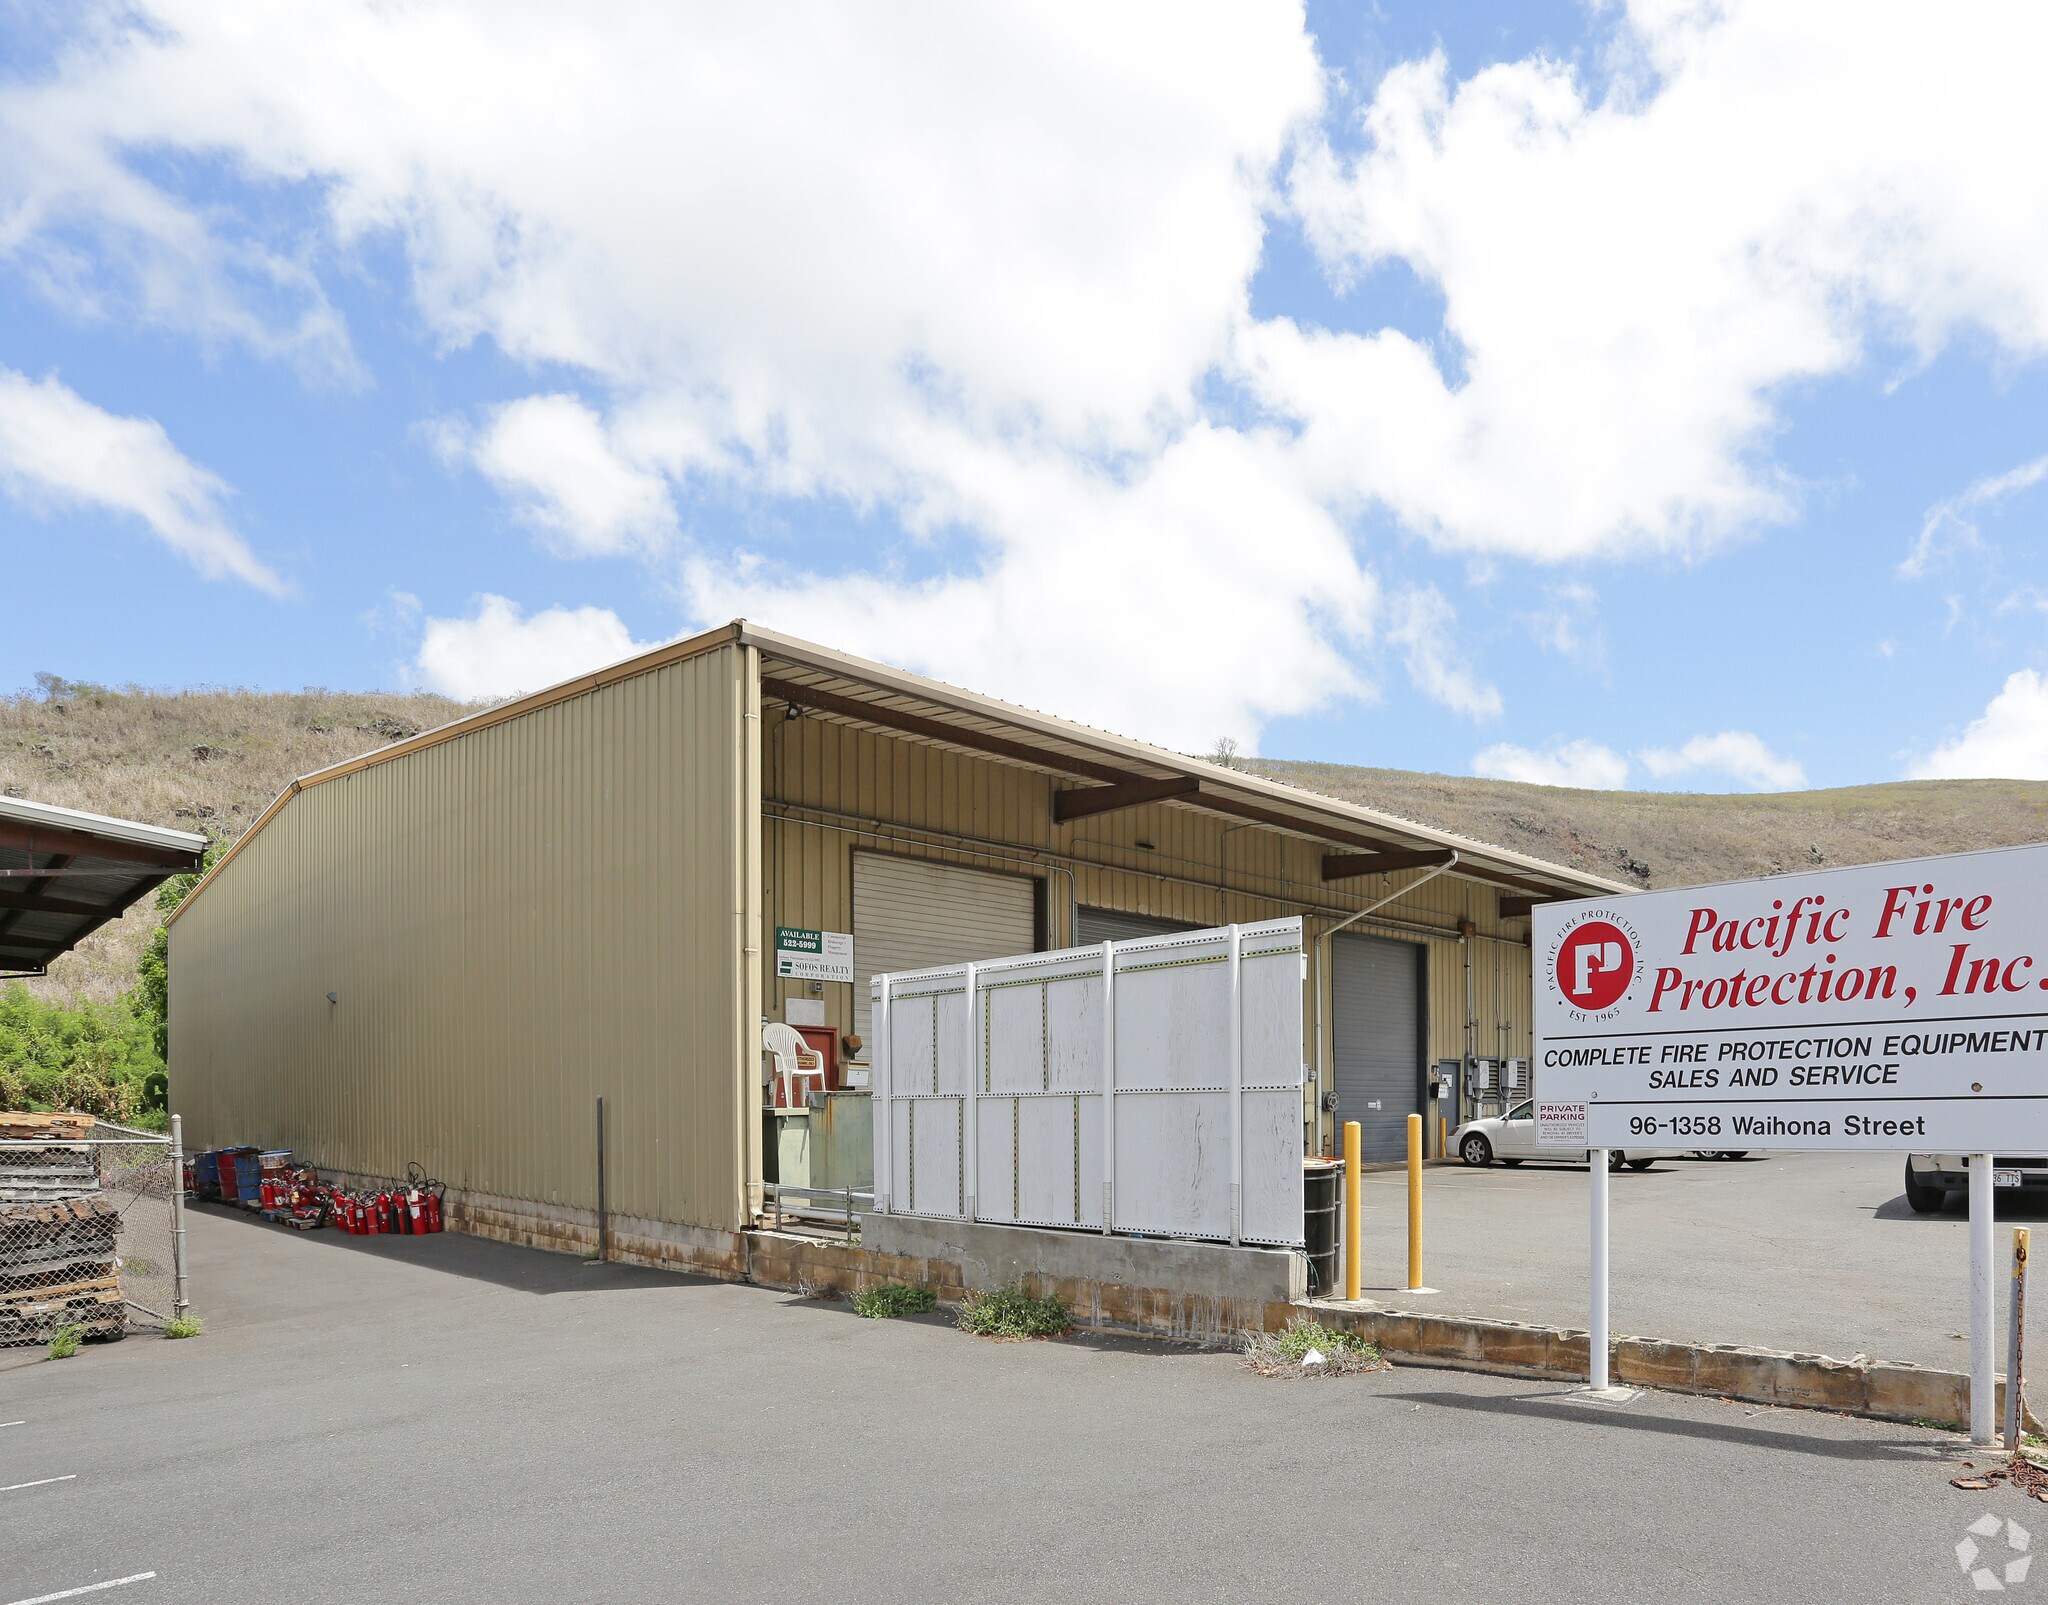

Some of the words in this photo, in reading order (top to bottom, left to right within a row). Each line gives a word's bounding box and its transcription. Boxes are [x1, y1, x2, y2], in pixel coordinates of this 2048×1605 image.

[1680, 895, 1850, 957] Pacific
[1872, 884, 1992, 938] Fire
[780, 930, 820, 940] AVAILABLE
[783, 939, 817, 949] 522-5999
[1546, 942, 1558, 990] PACIFIC
[1557, 917, 1578, 939] FIRE
[1632, 960, 1644, 986] INC.
[795, 962, 818, 972] SOFOS
[820, 964, 850, 974] REALTY
[795, 972, 849, 980] CORPORATION
[1646, 954, 1917, 1012] Protection,
[1936, 944, 2048, 996] Inc.
[1569, 1010, 1587, 1023] EST
[1595, 1007, 1620, 1023] 1965
[1544, 1046, 1652, 1067] COMPLETE
[1660, 1043, 1709, 1063] FIRE
[1718, 1037, 1872, 1061] PROTECTION
[1883, 1029, 2048, 1056] EQUIPMENT
[1648, 1068, 1720, 1089] SALES
[1728, 1067, 1778, 1087] AND
[1789, 1063, 1900, 1086] SERVICE
[1629, 1116, 1722, 1136] 96-1358
[1732, 1116, 1831, 1136] Waihona
[1844, 1114, 1926, 1136] Street
